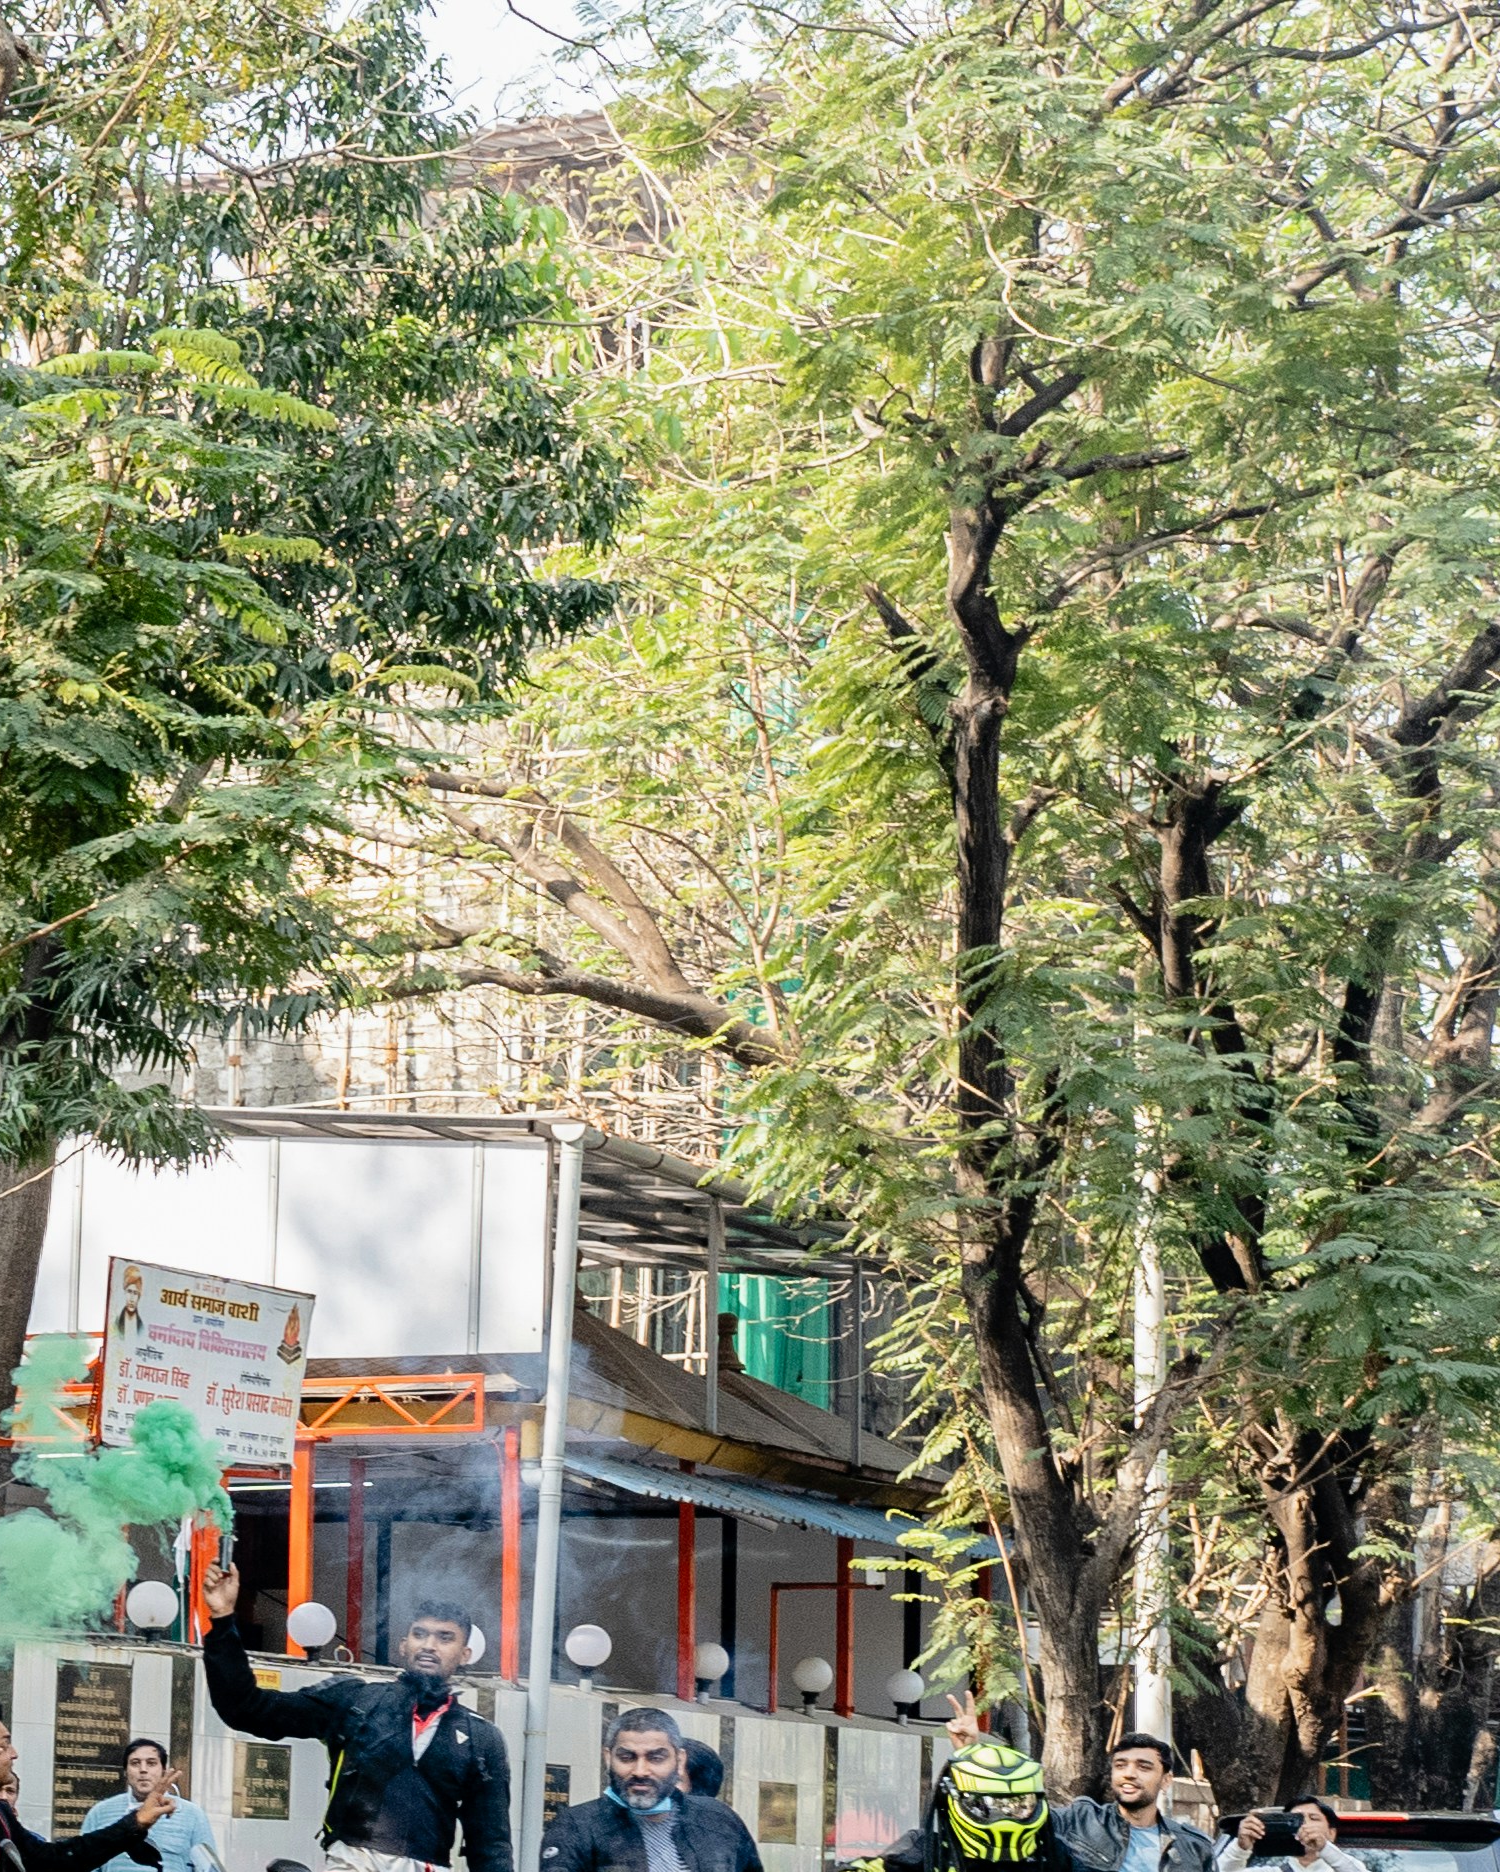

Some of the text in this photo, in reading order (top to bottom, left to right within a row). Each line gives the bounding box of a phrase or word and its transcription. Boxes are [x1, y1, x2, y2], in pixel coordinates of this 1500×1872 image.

[160, 1288, 189, 1309] आर्य
[190, 1294, 226, 1316] समाज
[227, 1301, 260, 1322] वाशी
[136, 1363, 169, 1386] रामराज
